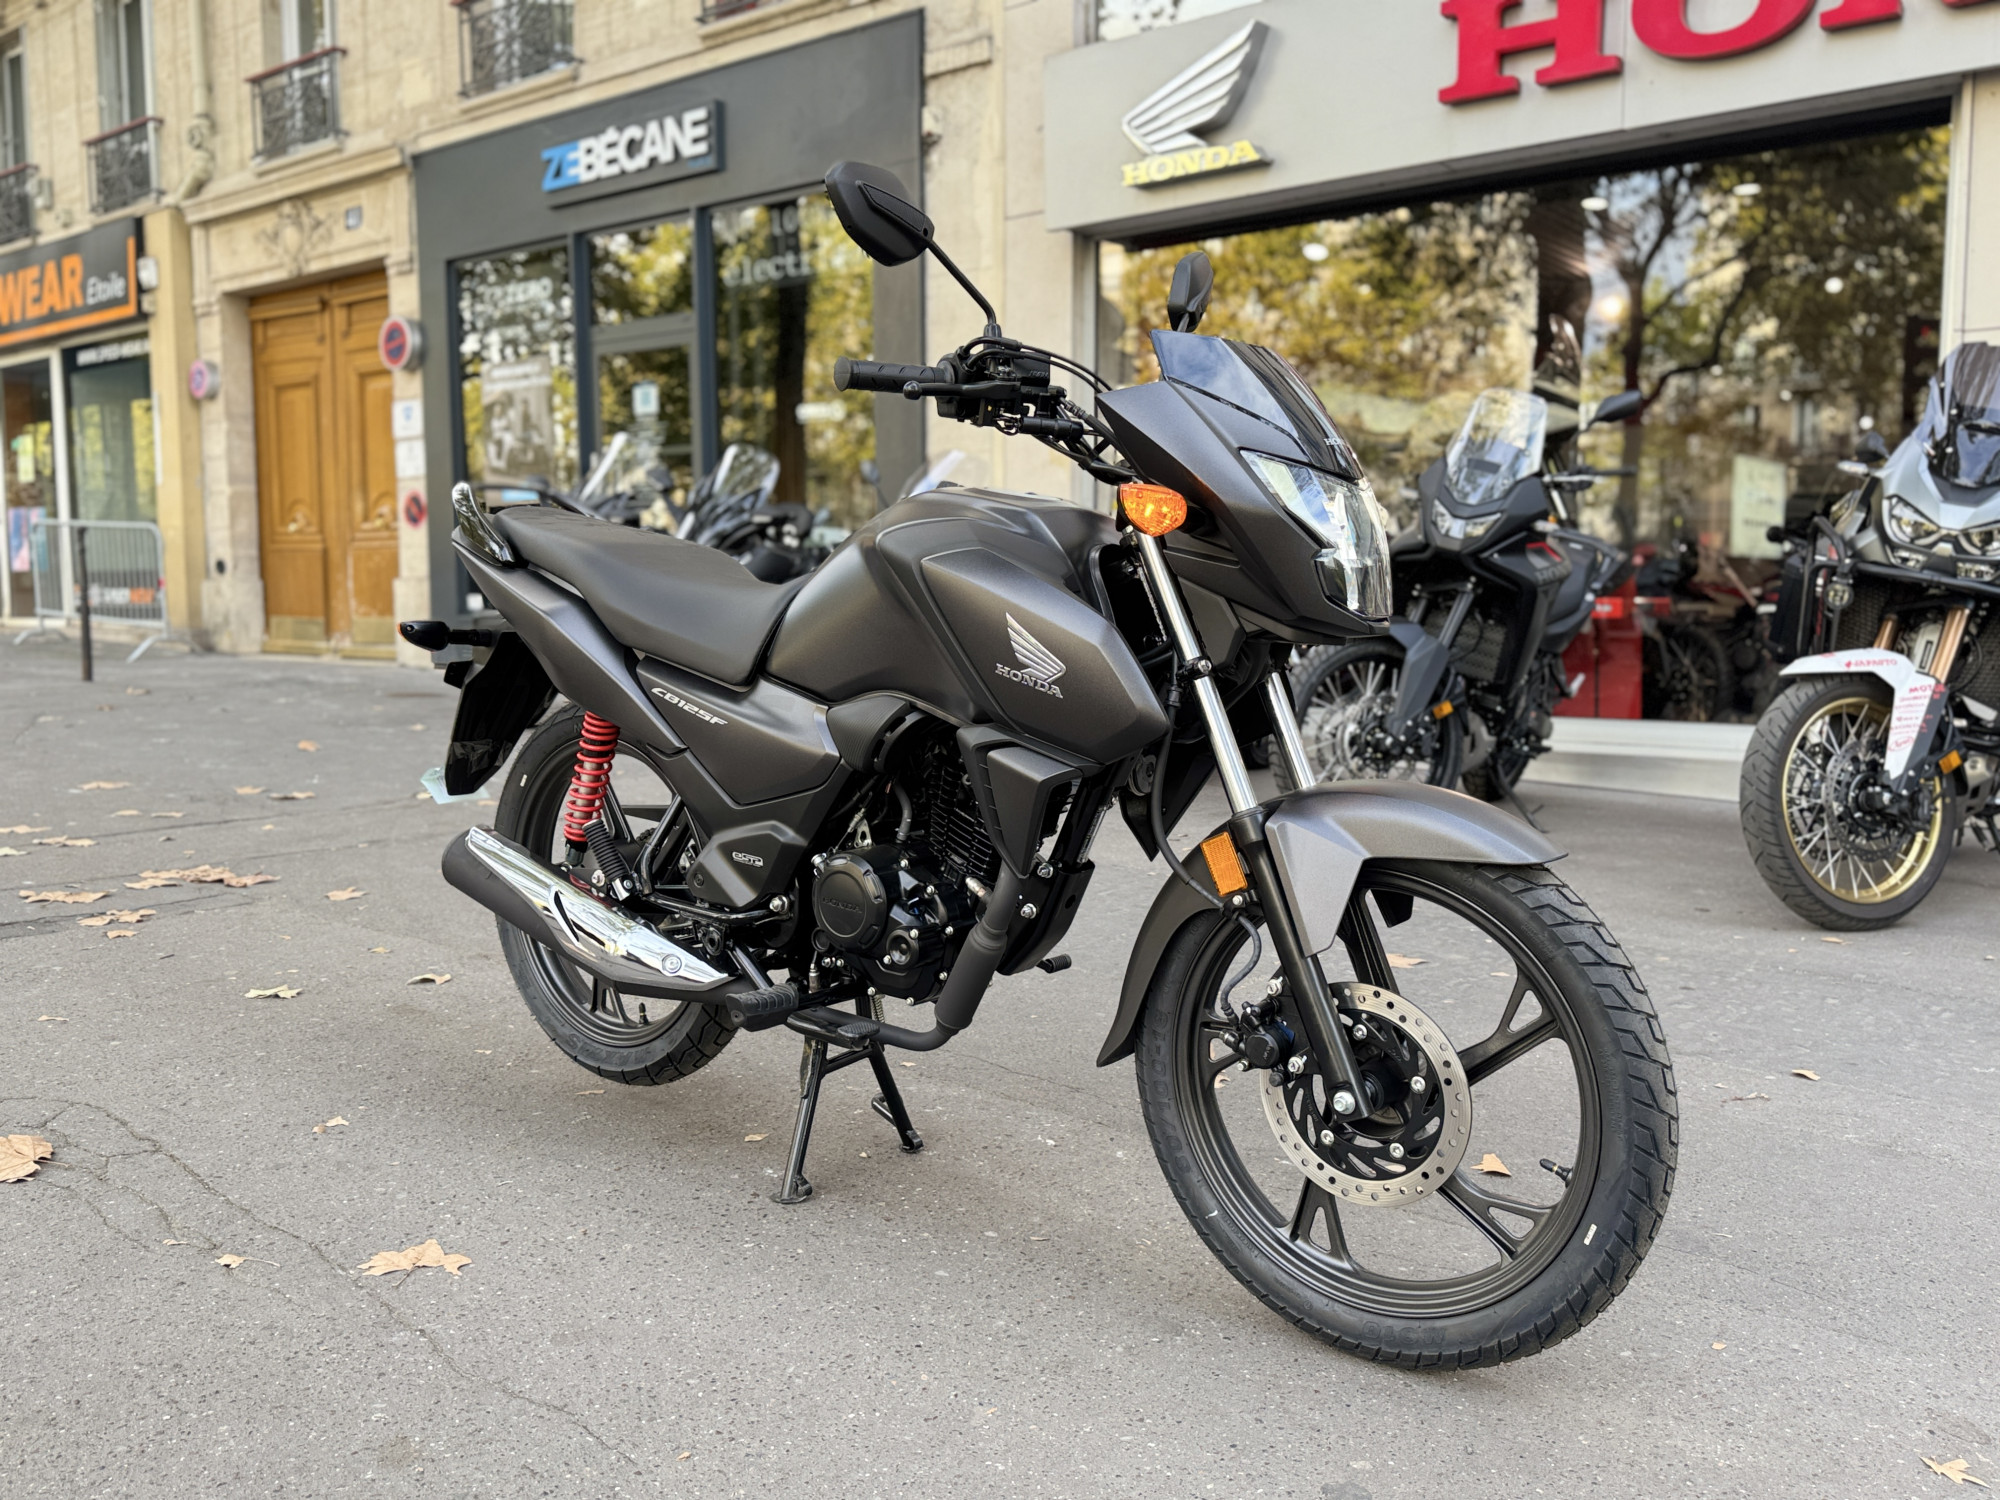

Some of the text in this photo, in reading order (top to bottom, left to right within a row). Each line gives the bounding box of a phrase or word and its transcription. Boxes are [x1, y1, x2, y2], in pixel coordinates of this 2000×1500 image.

[1439, 0, 2000, 104] HO
[541, 106, 709, 192] ZEBÉCANE
[1121, 139, 1261, 187] HONDA
[0, 253, 84, 326] WEAR
[995, 662, 1063, 699] HONDA
[651, 687, 728, 725] CB125F
[822, 897, 863, 914] HONDA
